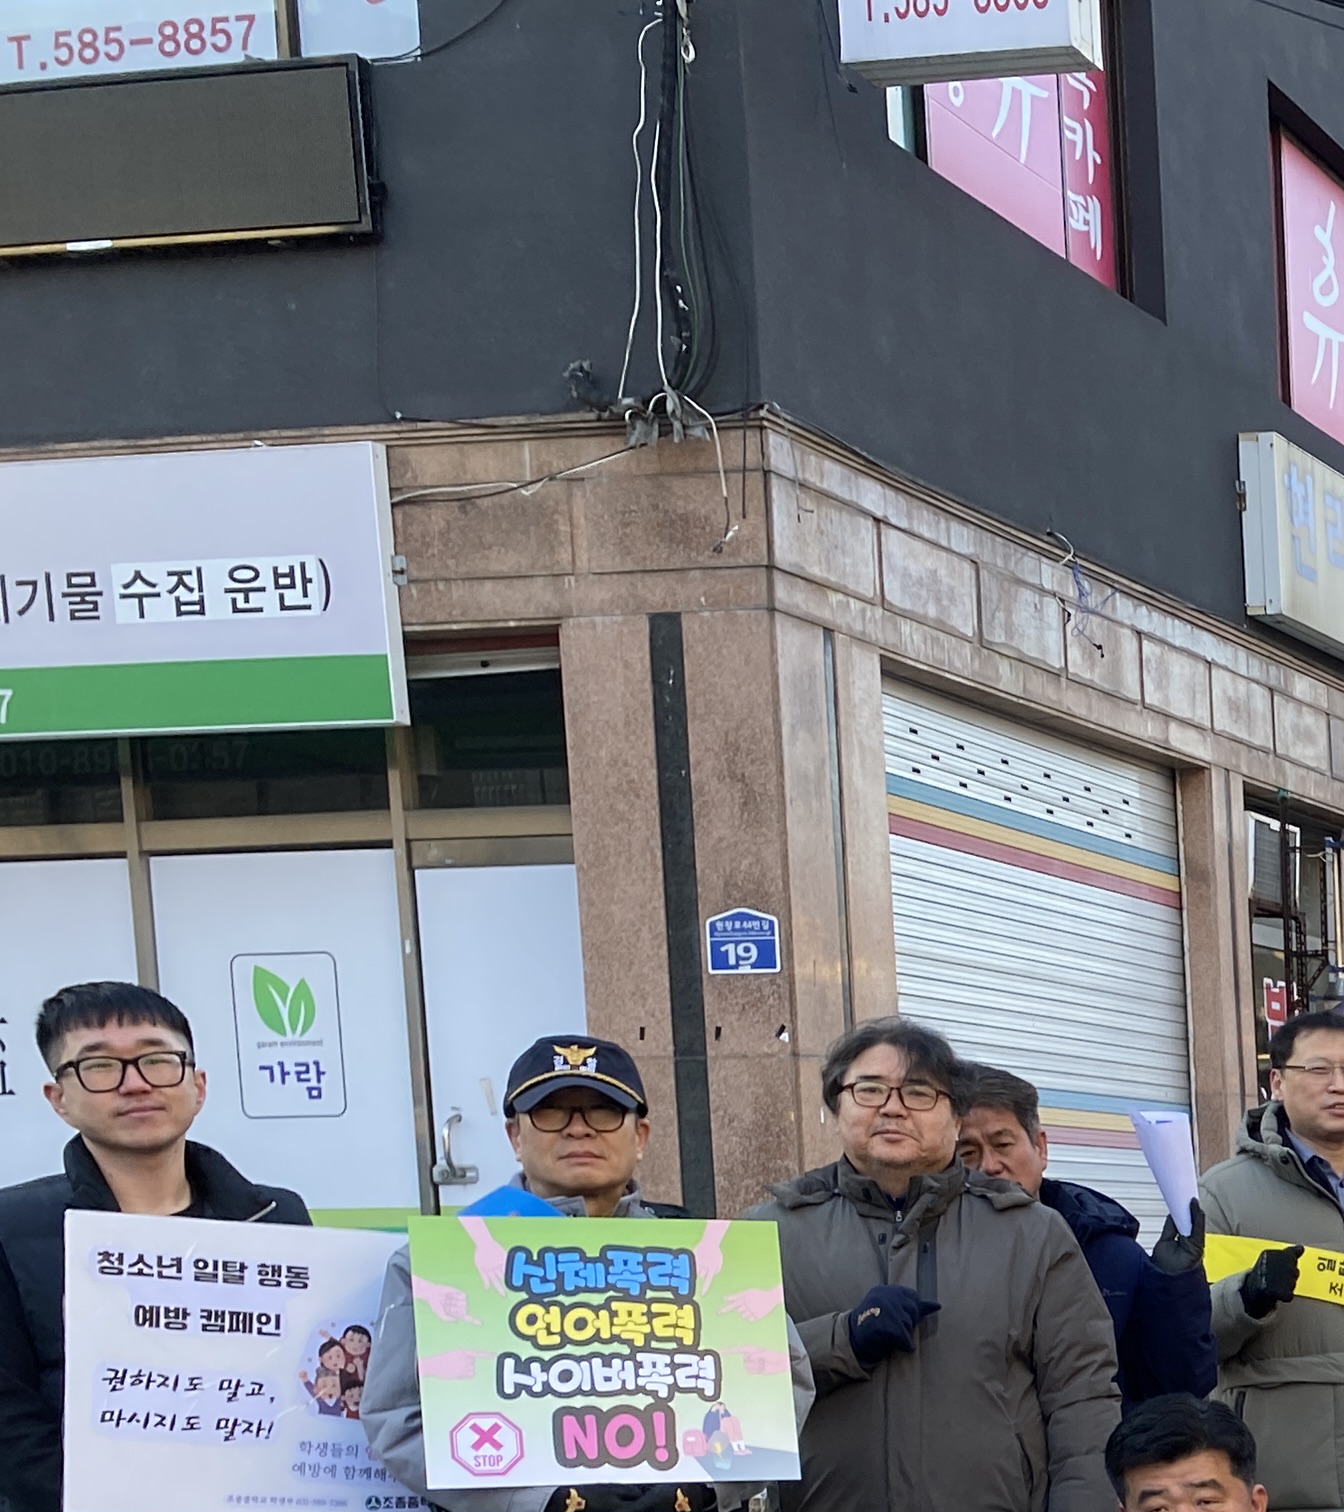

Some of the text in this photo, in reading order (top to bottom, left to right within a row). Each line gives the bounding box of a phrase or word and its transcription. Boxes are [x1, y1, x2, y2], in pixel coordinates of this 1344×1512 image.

[7, 14, 258, 71] T.585-8857
[118, 565, 205, 619] 수집
[224, 558, 333, 613] 운반)
[720, 942, 759, 966] 19
[258, 1059, 327, 1100] 가람
[96, 1250, 311, 1290] 청소년 일탈 행동
[511, 1249, 691, 1296] 신체폭력
[134, 1305, 283, 1338] 예방 캠페인
[515, 1301, 696, 1347] 언어폭력
[101, 1367, 276, 1404] 권하지도 말고,
[502, 1353, 718, 1398] 사이버폭력
[99, 1409, 275, 1443] 마시지도 말자!
[562, 1411, 672, 1463] NO!
[298, 1440, 360, 1461] 학생들의
[474, 1454, 504, 1468] STOP
[291, 1462, 338, 1480] 예방에
